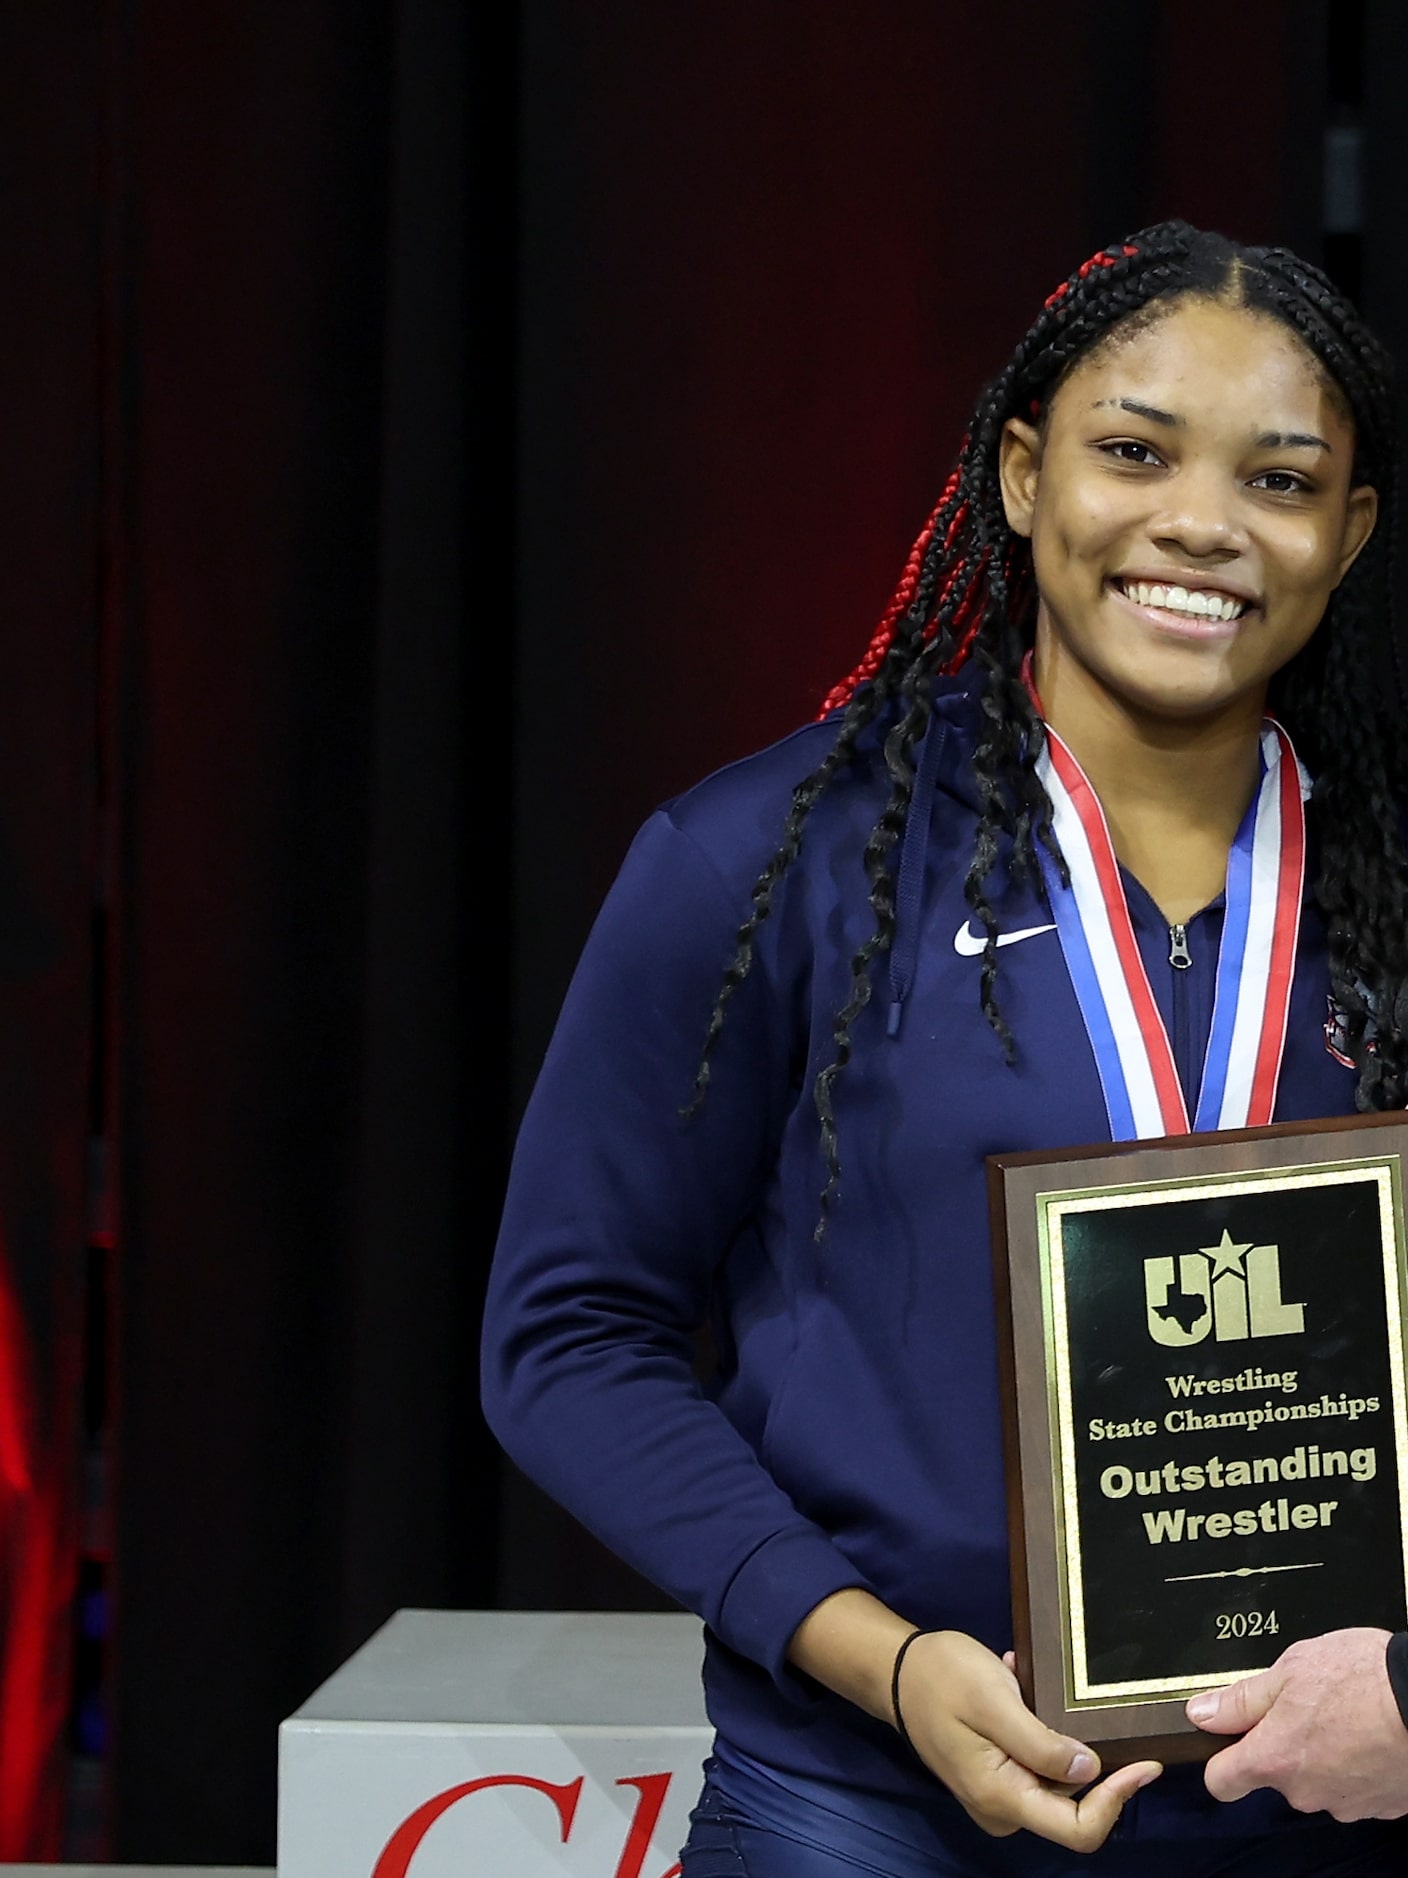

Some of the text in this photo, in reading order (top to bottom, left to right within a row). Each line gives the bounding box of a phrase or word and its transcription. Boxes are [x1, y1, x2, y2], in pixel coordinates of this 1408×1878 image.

[1165, 1368, 1298, 1399] Wrestling
[1089, 1392, 1381, 1441] State Championships
[1100, 1445, 1377, 1499] Outstanding
[1141, 1498, 1339, 1545] Wrestler
[1216, 1610, 1280, 1640] 2024
